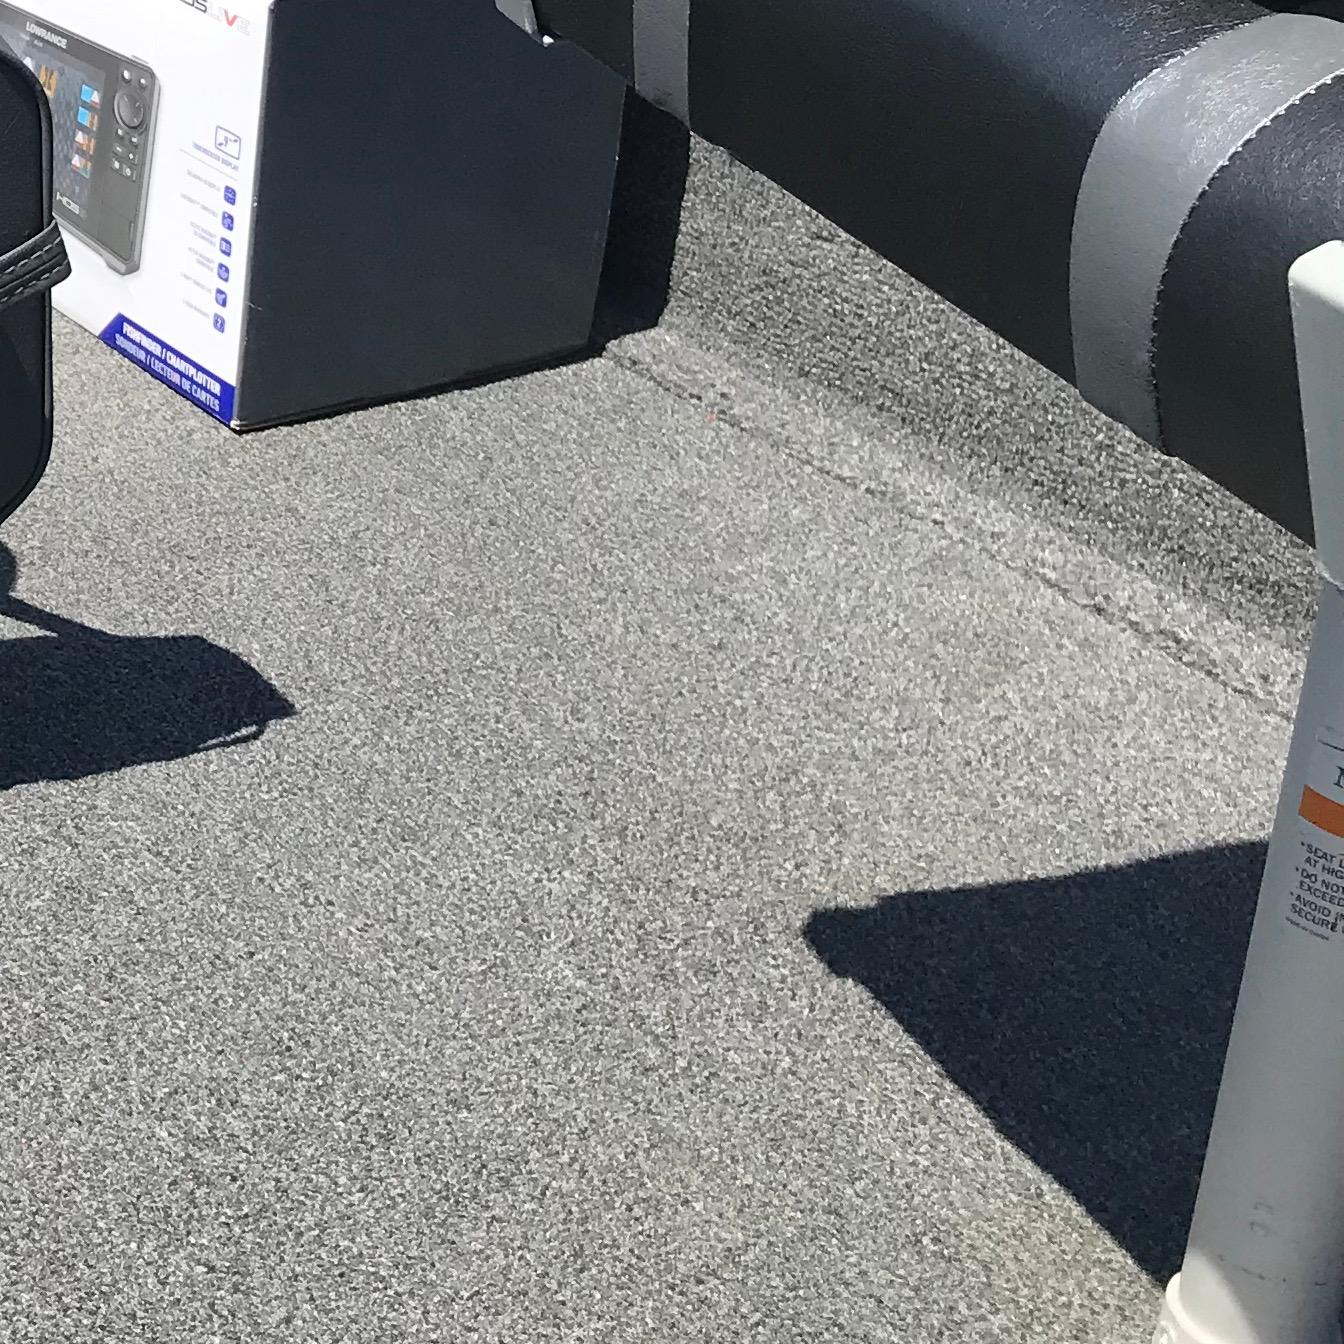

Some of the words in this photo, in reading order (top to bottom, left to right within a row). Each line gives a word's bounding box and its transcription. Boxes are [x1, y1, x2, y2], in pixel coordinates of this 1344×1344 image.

[25, 21, 68, 49] LOWRANCE
[150, 357, 181, 386] LECTEUR
[181, 377, 192, 394] DE
[192, 384, 220, 412] CARTES
[166, 350, 221, 396] CHARTPLOTTER
[1304, 856, 1319, 868] AT
[1306, 844, 1336, 864] SEAT
[1301, 868, 1317, 884] DO
[1290, 903, 1338, 933] SECURE
[1295, 894, 1332, 918] AVOID
